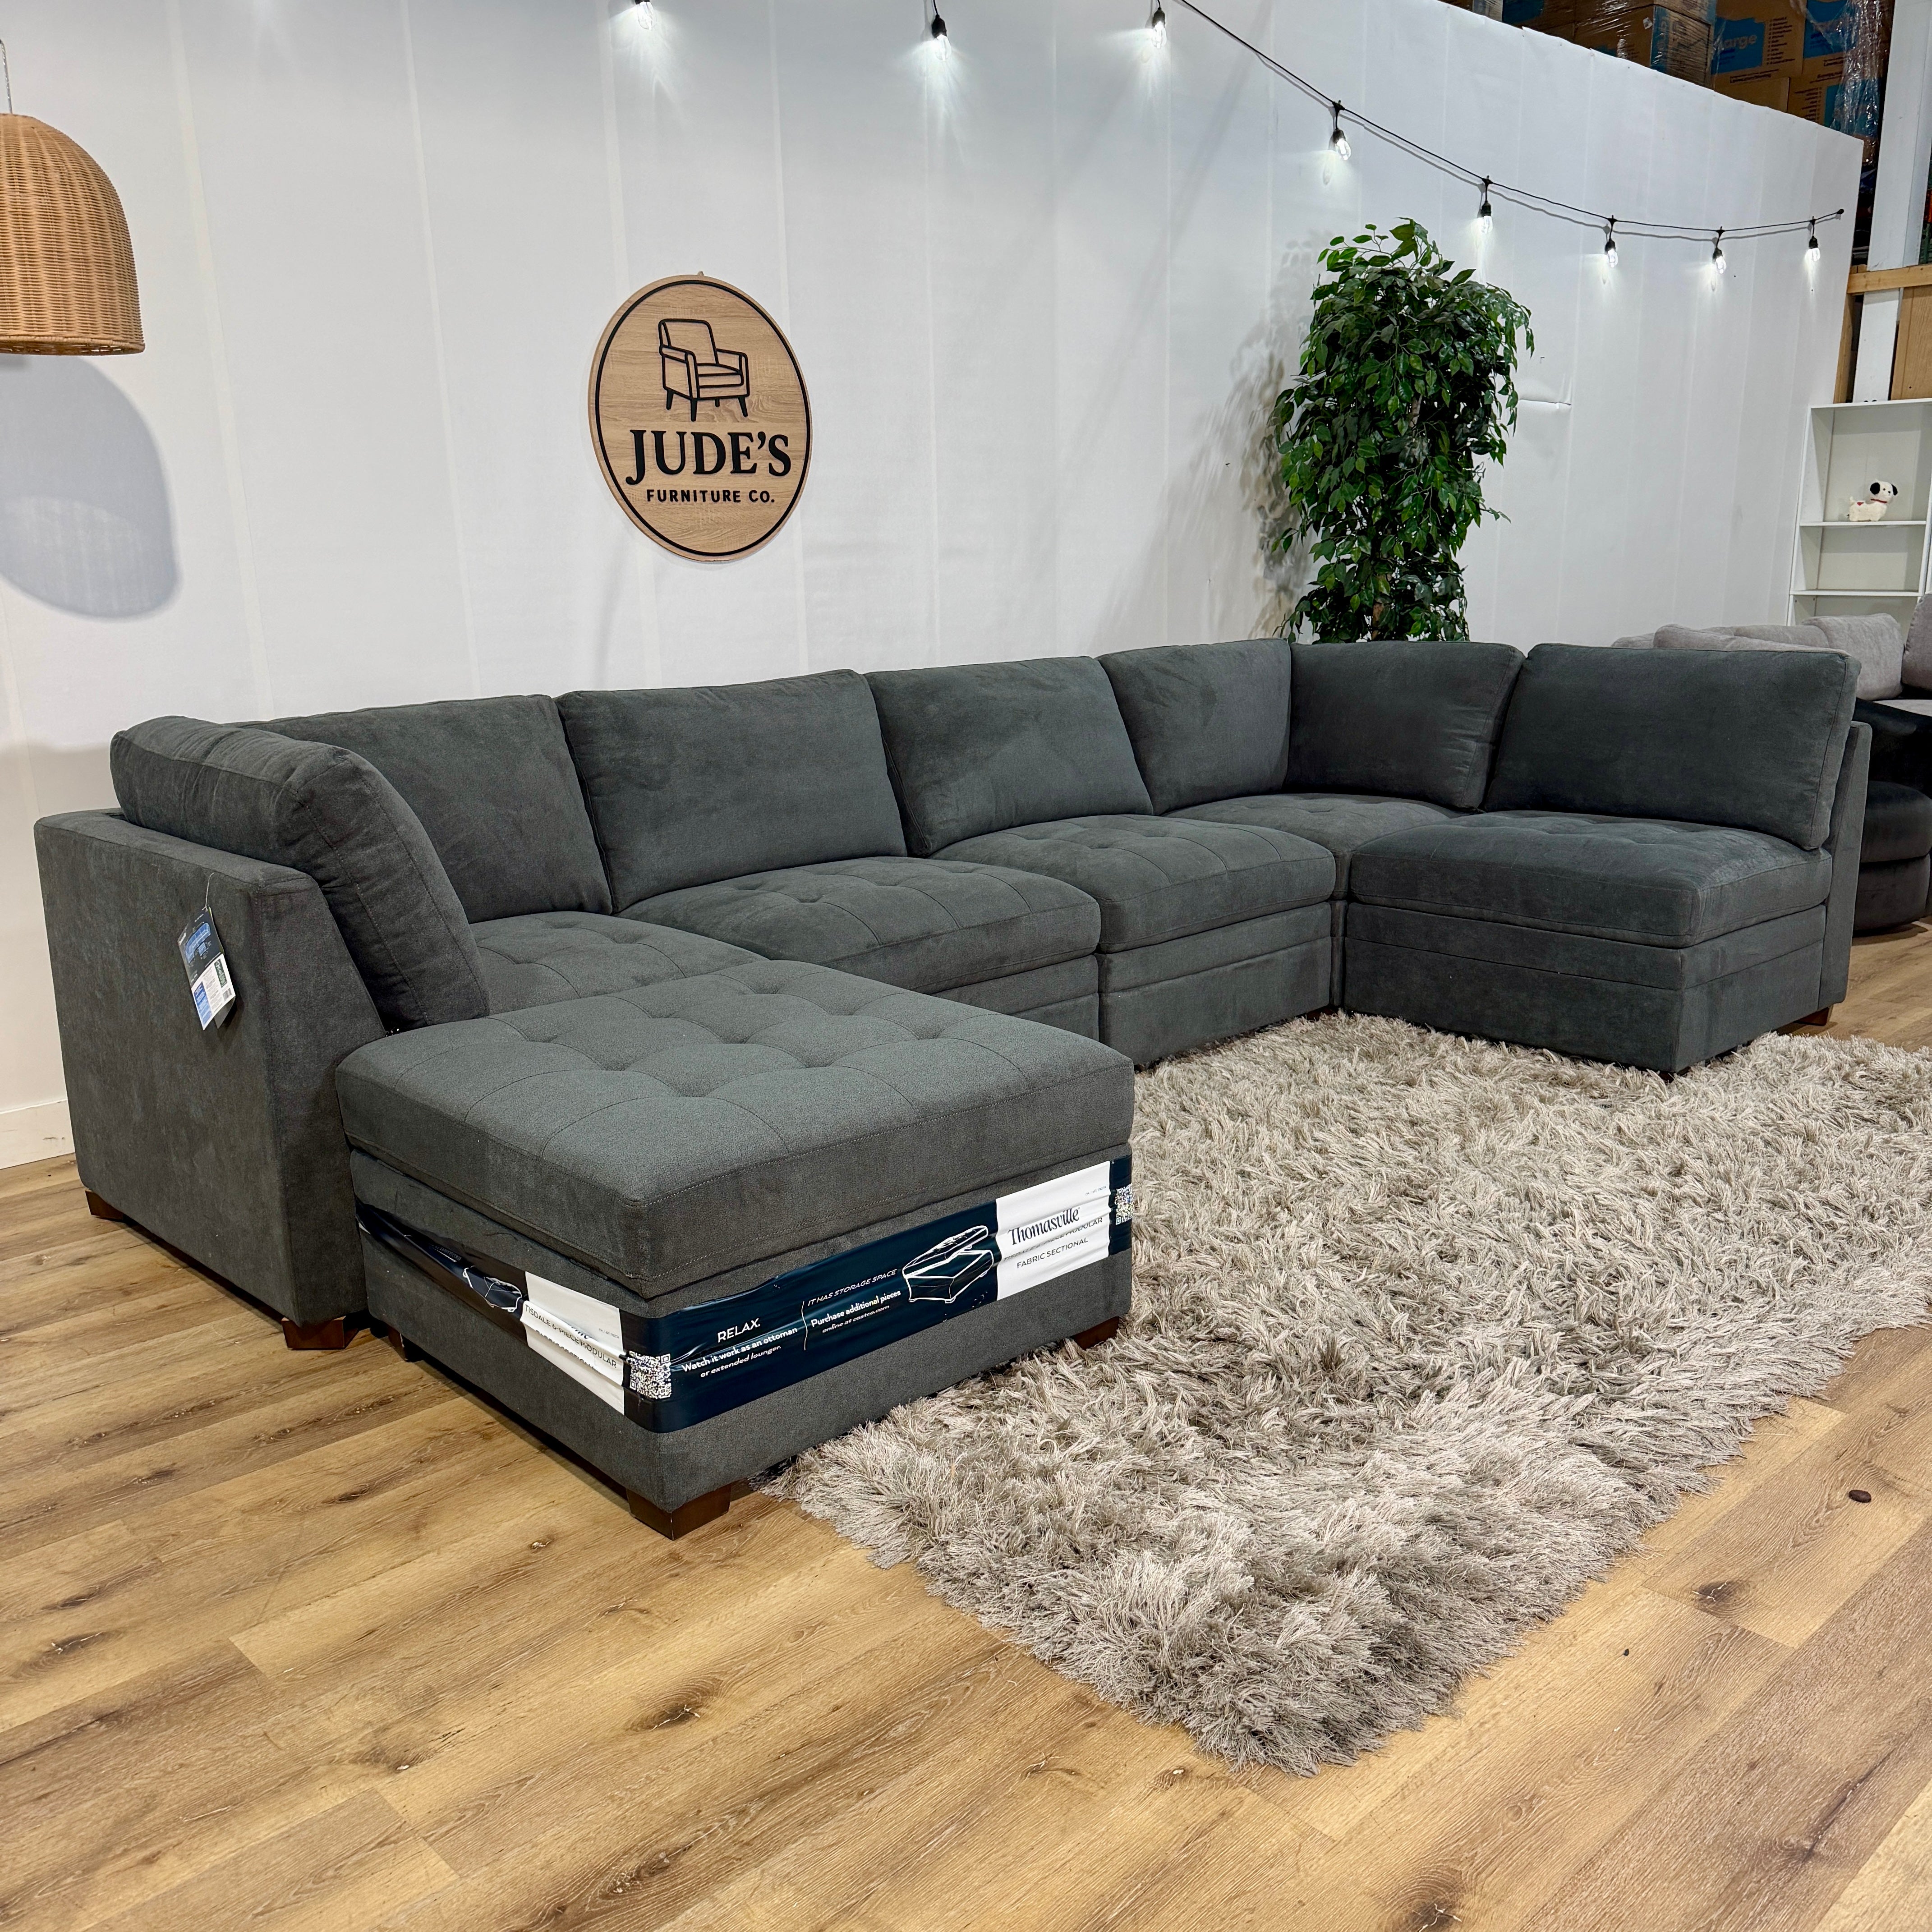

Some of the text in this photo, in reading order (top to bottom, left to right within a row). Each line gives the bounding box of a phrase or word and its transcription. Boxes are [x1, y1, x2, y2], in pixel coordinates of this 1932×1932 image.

[1719, 35, 1757, 50] arge
[626, 429, 791, 485] JUDE'S
[646, 489, 775, 503] FURNITURE CO.
[1007, 1207, 1080, 1246] Thomasville
[1017, 1252, 1045, 1269] FABRIC
[1046, 1237, 1089, 1258] SECTIONAL
[808, 1269, 897, 1306] IT HAS STORAGE SPACE
[811, 1290, 901, 1327] Purchase additional pieces
[822, 1323, 844, 1333] online
[853, 1305, 890, 1322] costco.com
[524, 1304, 552, 1326] TISDALE
[552, 1323, 580, 1344] 6-PIECE
[580, 1341, 617, 1369] MODULAR
[718, 1318, 761, 1343] RELAX.
[681, 1327, 798, 1372] Watch it work as an ottoman
[711, 1354, 750, 1374] extended
[750, 1344, 781, 1360] lounger.
